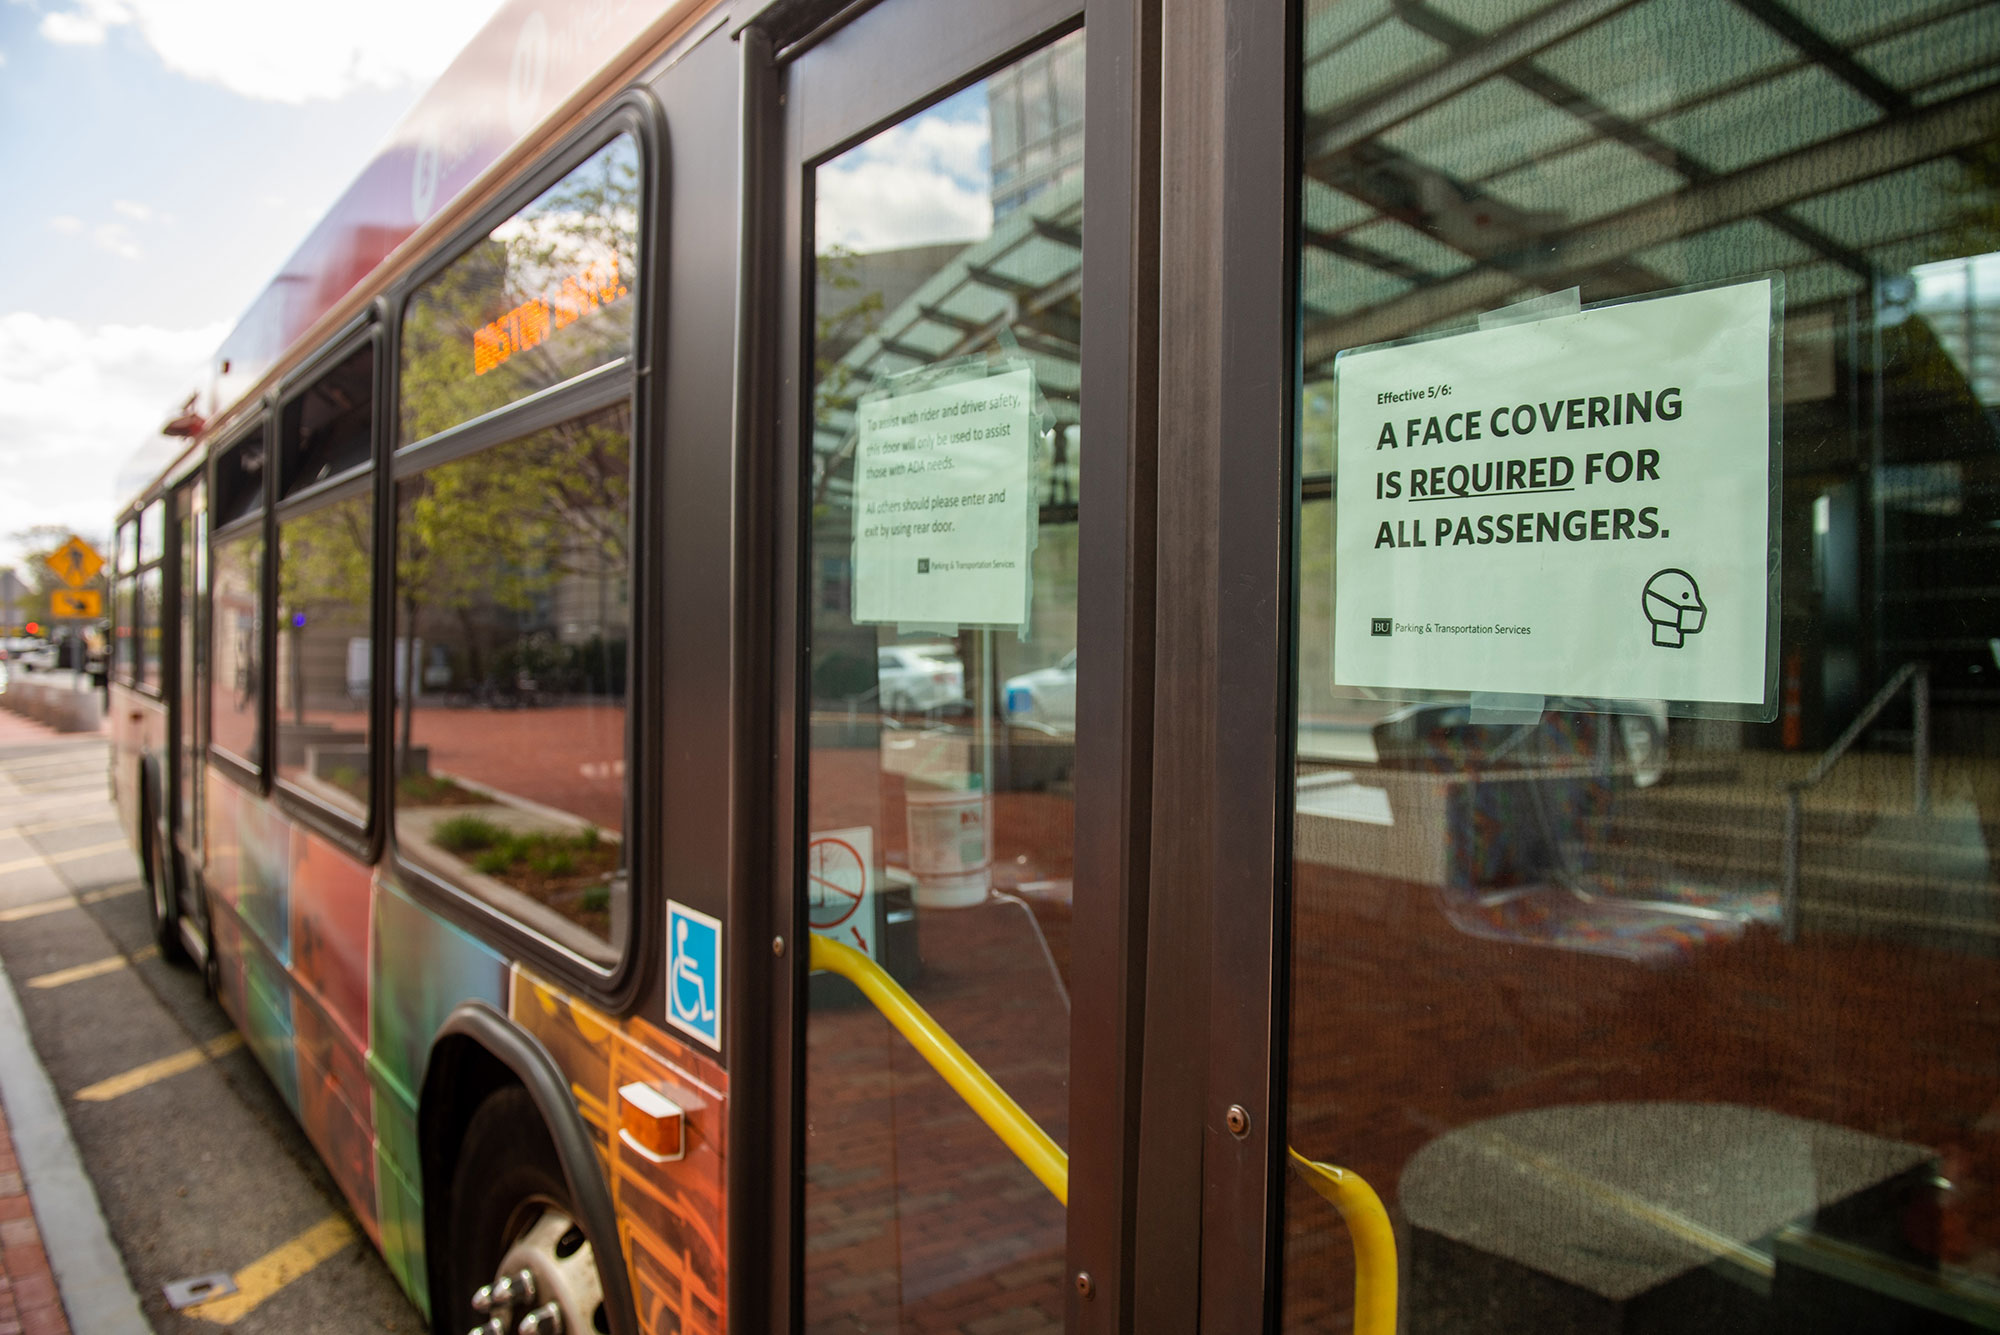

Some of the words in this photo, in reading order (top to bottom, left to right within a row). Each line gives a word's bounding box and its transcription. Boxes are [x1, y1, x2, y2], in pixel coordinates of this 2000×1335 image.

[1377, 387, 1424, 405] Effective
[1428, 385, 1452, 401] 5/6:
[901, 410, 918, 425] with
[920, 408, 940, 422] rider
[942, 404, 958, 419] and
[961, 399, 986, 415] driver
[989, 394, 1021, 411] safety,
[1376, 422, 1398, 451] A
[1406, 411, 1481, 448] FACE
[1490, 387, 1682, 438] COVERING
[882, 441, 901, 455] door
[902, 438, 915, 451] will
[917, 435, 934, 451] only
[937, 433, 947, 446] be
[950, 430, 971, 445] used
[973, 428, 984, 441] to
[985, 424, 1011, 438] assist
[866, 466, 887, 480] those
[889, 464, 905, 477] with
[908, 461, 925, 473] ADA
[927, 458, 955, 471] needs.
[1376, 471, 1402, 499] IS
[1409, 456, 1574, 499] REQUIRED
[1585, 449, 1660, 485] FOR
[866, 502, 875, 515] All
[877, 499, 901, 514] others
[902, 495, 929, 512] should
[931, 494, 959, 513] please
[961, 493, 986, 505] enter
[988, 489, 1005, 504] and
[865, 524, 879, 537] exit
[881, 522, 889, 539] by
[891, 520, 911, 537] using
[914, 520, 930, 534] rear
[932, 519, 955, 532] door.
[1374, 521, 1427, 549] ALL
[1435, 506, 1669, 547] PASSENGERS.
[993, 559, 1015, 569] Services
[1374, 620, 1390, 634] BU
[1395, 622, 1424, 636] Parking
[1425, 624, 1433, 634] &
[1434, 623, 1493, 636] Transportation
[1494, 623, 1531, 635] Services
